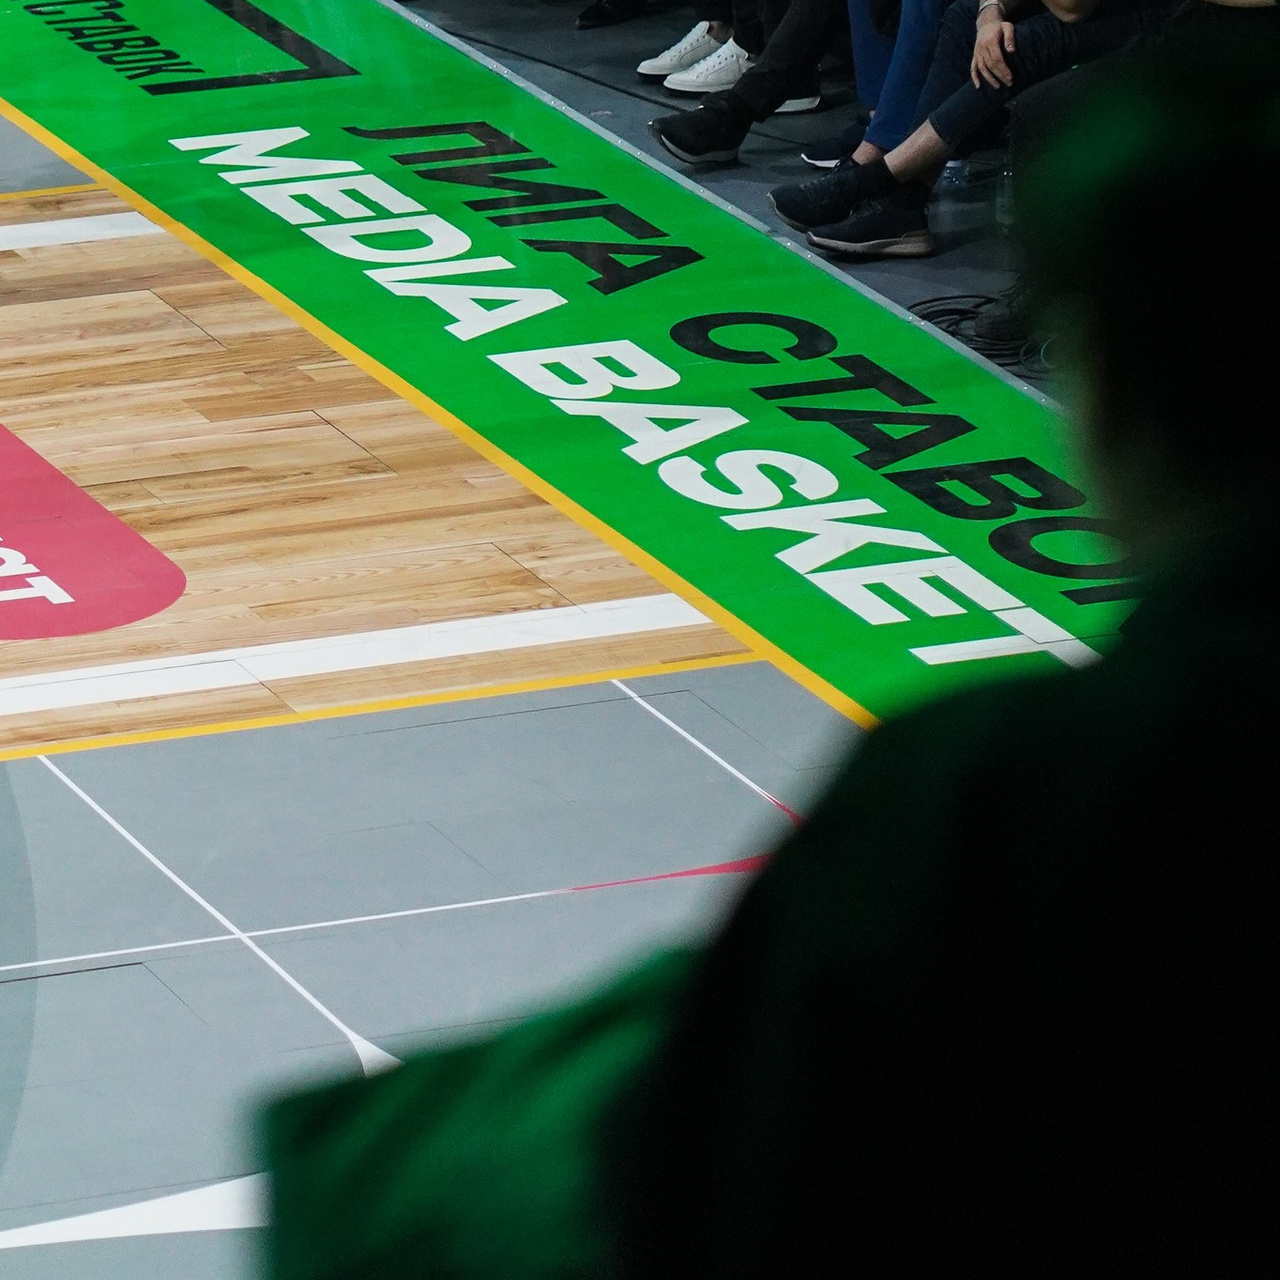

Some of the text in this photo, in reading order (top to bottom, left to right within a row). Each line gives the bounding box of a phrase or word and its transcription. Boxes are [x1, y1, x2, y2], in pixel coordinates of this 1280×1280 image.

[342, 121, 706, 295] ЛИГА
[167, 126, 1102, 670] MEDIA BASKET
